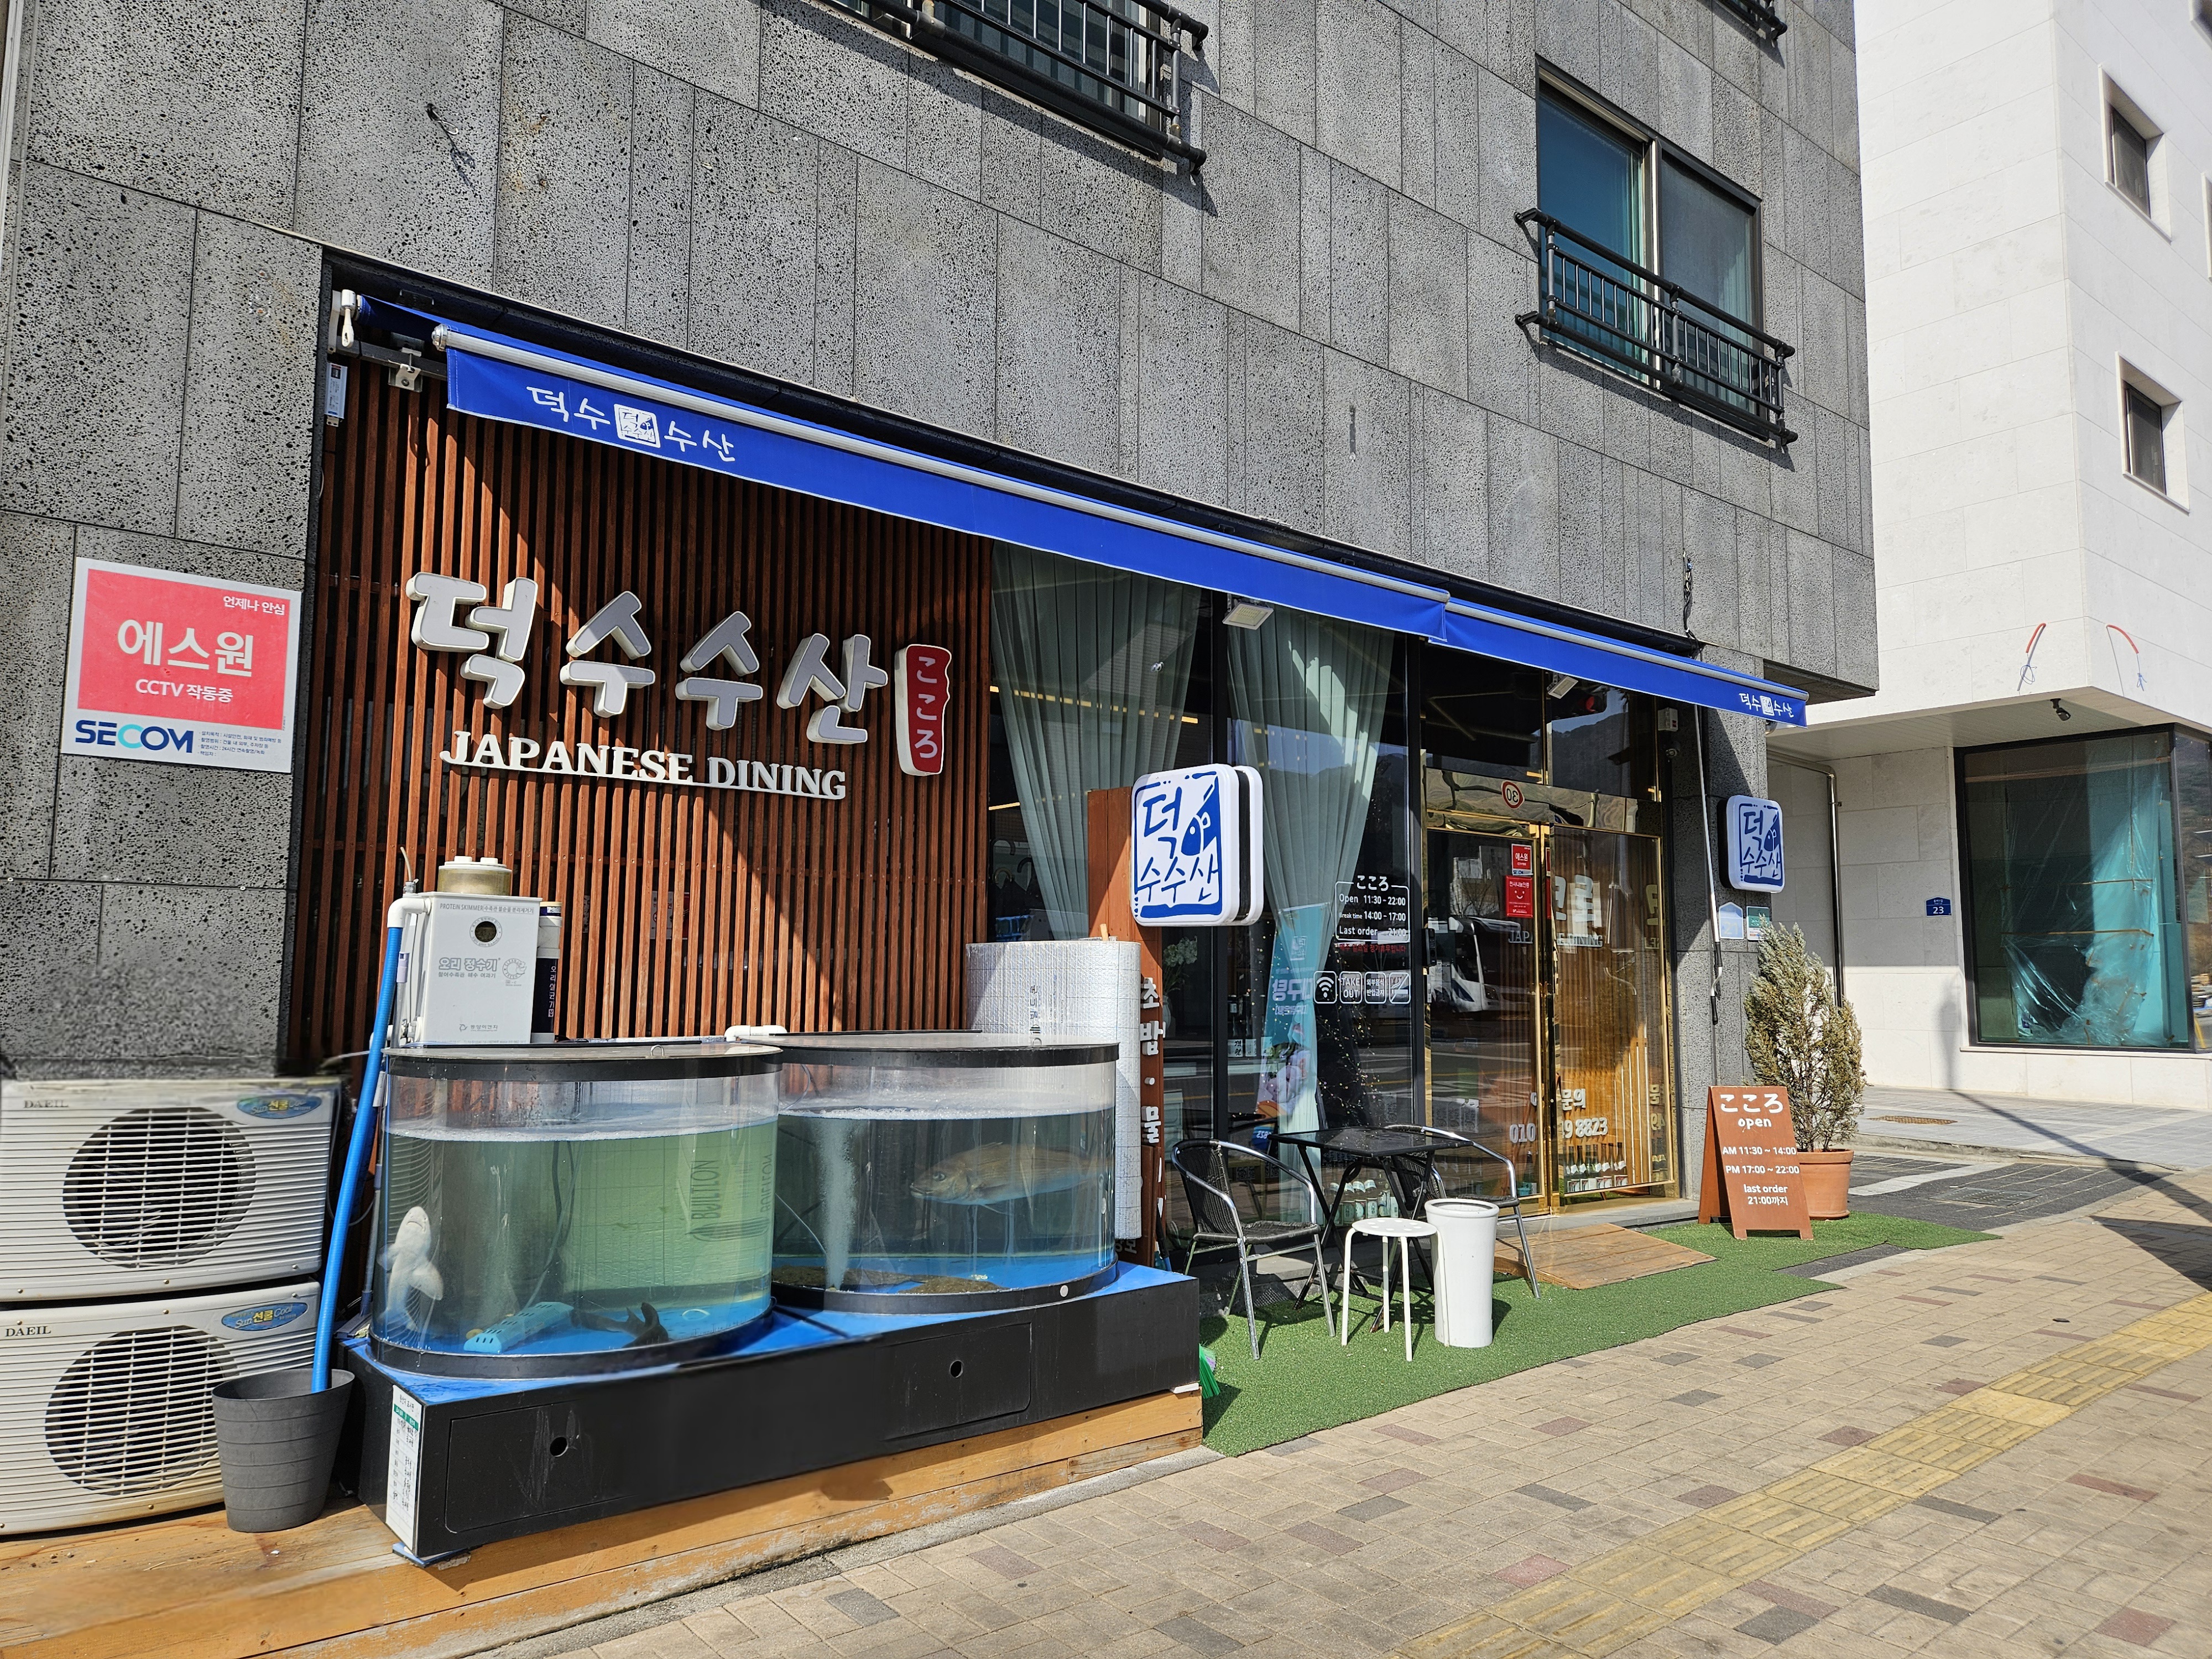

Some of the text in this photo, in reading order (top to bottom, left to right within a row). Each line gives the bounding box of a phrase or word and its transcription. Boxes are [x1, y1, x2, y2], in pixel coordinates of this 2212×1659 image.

[526, 386, 735, 462] 덕수 수산
[223, 596, 285, 616] 언제나 안심
[118, 619, 254, 677] 에스원
[406, 571, 889, 744] 덕수수산
[135, 679, 233, 703] CCTV 작동중
[914, 656, 941, 760] こころ
[1739, 693, 1761, 711] 덕수
[1773, 700, 1794, 718] 수산
[75, 719, 194, 753] SECOM
[439, 729, 846, 800] JAPANESE DINING
[1142, 786, 1182, 859] 덕
[1744, 810, 1764, 851] 덕
[1515, 852, 1528, 862] 에스원
[1742, 846, 1781, 878] 수수산
[1136, 854, 1219, 903] 수수산
[1357, 875, 1389, 891] こころ
[1339, 894, 1359, 904] Open
[1363, 895, 1382, 905] 11:30
[1387, 896, 1406, 906] 22:00
[1364, 911, 1382, 920] 14:00
[1389, 912, 1406, 922] 17:00
[1339, 926, 1407, 937] Last order 21:00
[439, 957, 498, 972] 오리 정수기
[1342, 978, 1360, 986] TAKE
[1366, 978, 1385, 987] 외부음식
[1343, 989, 1359, 998] OUT
[1366, 989, 1385, 997] 반입금지
[23, 1099, 69, 1109] DAEIL
[1720, 1093, 1783, 1114] こころ
[1509, 1123, 1536, 1144] 010
[1575, 1117, 1608, 1138] 8823
[1738, 1118, 1772, 1130] open
[1722, 1146, 1737, 1155] AM
[1739, 1146, 1762, 1155] 11:30
[1773, 1146, 1797, 1155] 14:00
[1725, 1165, 1740, 1174] PM
[1742, 1165, 1766, 1174] 17:00
[1775, 1165, 1800, 1174] 22:00
[1744, 1184, 1788, 1193] last order
[1747, 1196, 1788, 1206] 21:00까지
[253, 1310, 274, 1323] 선쿨
[273, 1305, 293, 1318] Cool
[234, 1318, 253, 1329] Sun
[6, 1326, 51, 1337] DAEIL
